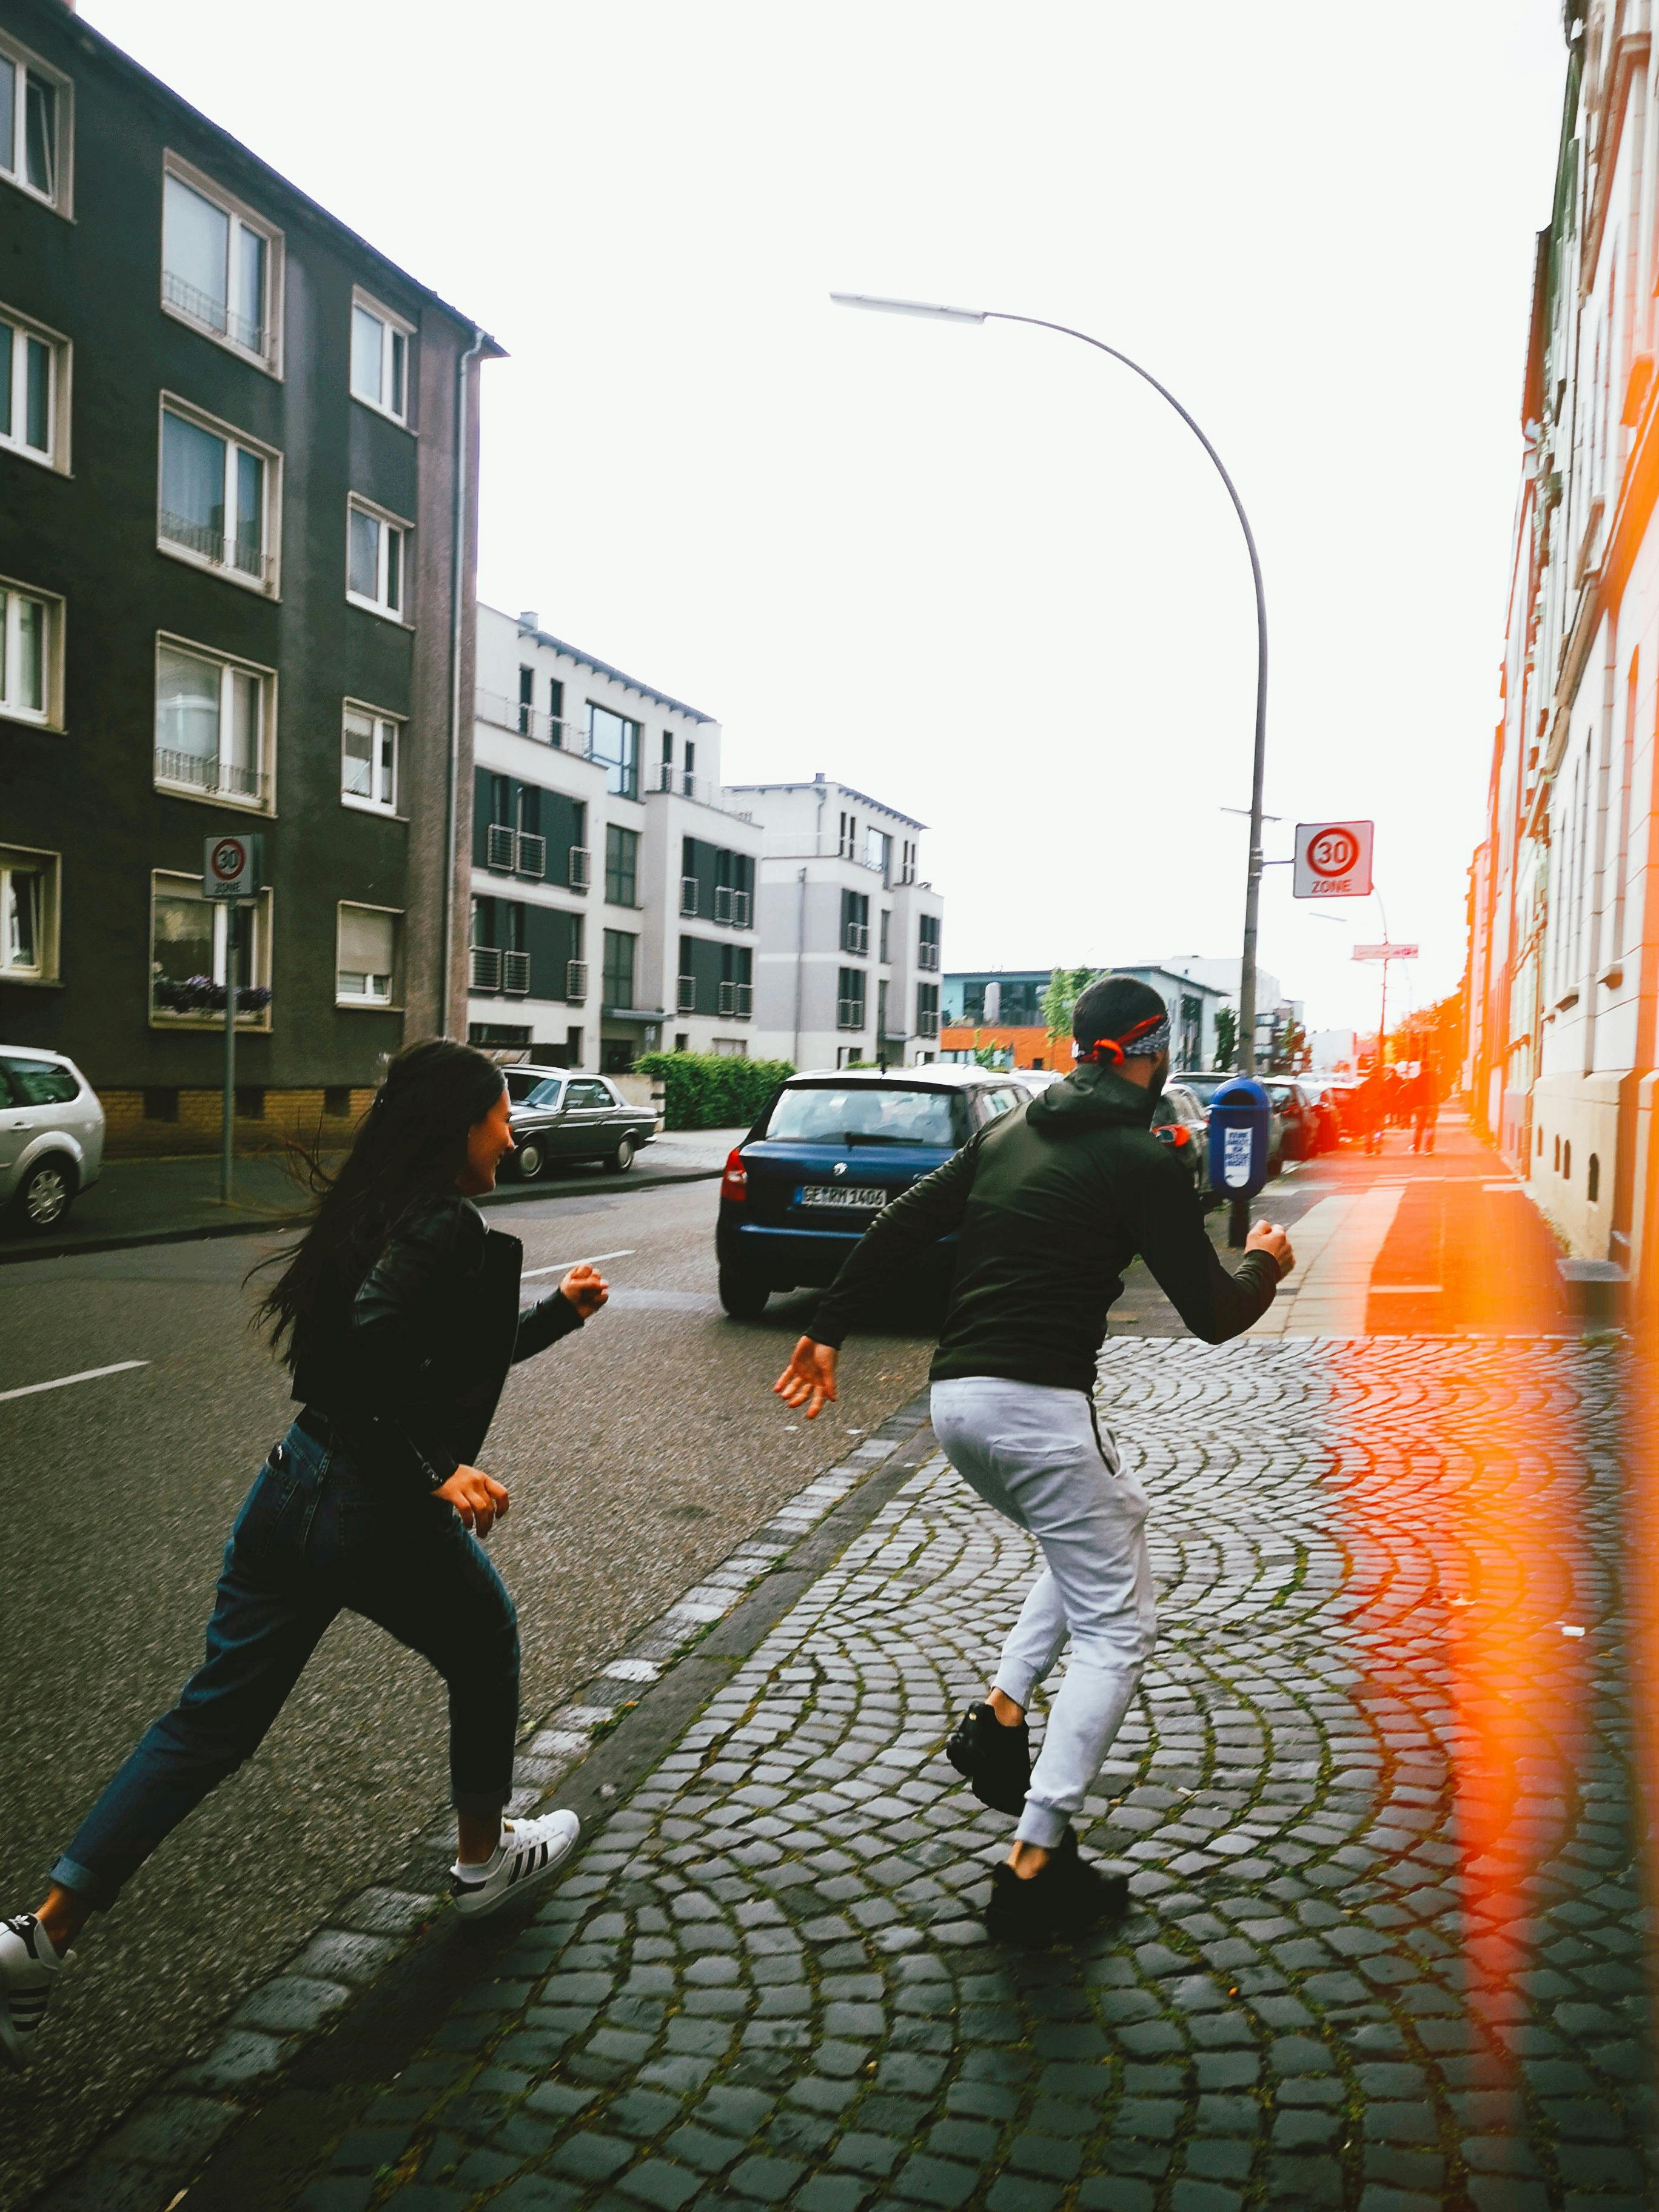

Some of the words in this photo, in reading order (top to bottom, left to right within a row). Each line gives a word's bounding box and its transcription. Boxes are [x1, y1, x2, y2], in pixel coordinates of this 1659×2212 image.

[218, 850, 238, 869] 30
[1318, 840, 1348, 863] 30
[1311, 879, 1352, 893] ZONE
